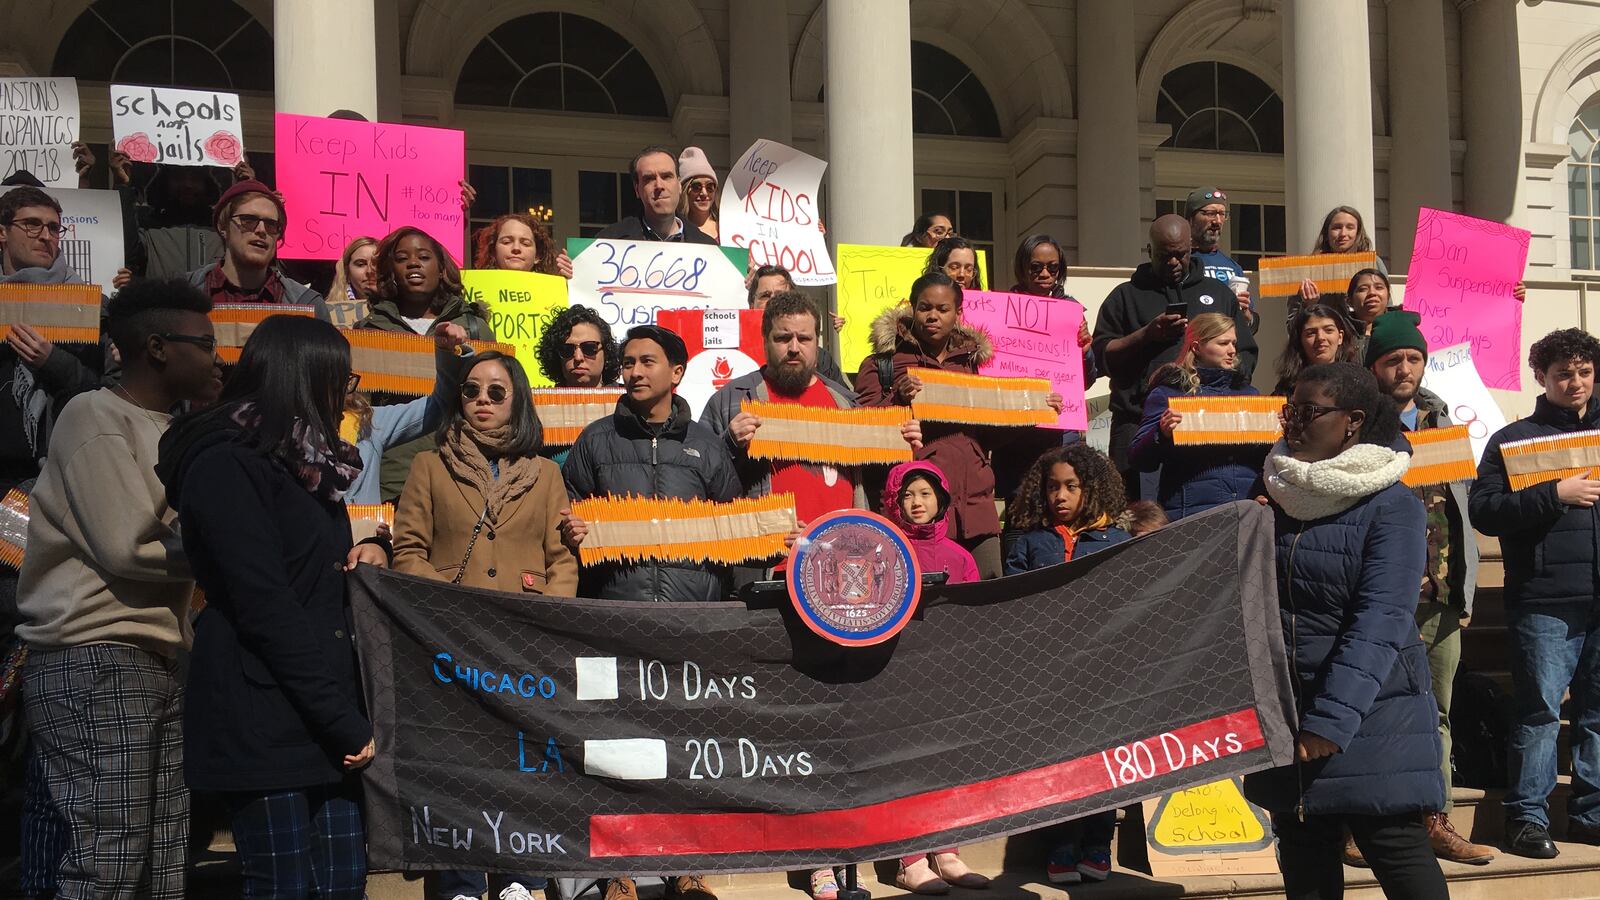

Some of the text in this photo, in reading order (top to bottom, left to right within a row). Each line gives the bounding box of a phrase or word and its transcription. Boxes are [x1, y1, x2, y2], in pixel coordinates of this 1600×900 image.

[0, 81, 59, 111] NSIONS
[116, 88, 236, 122] schools
[157, 119, 188, 130] not
[155, 125, 204, 162] jails
[295, 120, 418, 165] Keep Kids
[743, 142, 778, 181] Keep
[319, 170, 390, 223] IN
[745, 176, 812, 226] KIDS
[410, 205, 462, 227] too many
[756, 222, 779, 239] IN
[731, 233, 834, 276] SCHOOL
[1425, 218, 1469, 265] Ban
[595, 242, 708, 291] 36,668
[499, 289, 532, 304] NEED
[850, 269, 900, 302] Tale
[704, 311, 737, 320] schools
[1004, 295, 1058, 331] NOT
[1419, 298, 1452, 318] Over
[704, 337, 723, 346] jails
[1431, 325, 1492, 354] 20 days
[845, 609, 868, 618] 1625
[432, 652, 557, 700] CHICAGO
[638, 659, 669, 701] 10
[518, 730, 564, 774] LA
[685, 739, 725, 780] 20
[1101, 740, 1156, 788] 180
[1172, 801, 1242, 826] belong in
